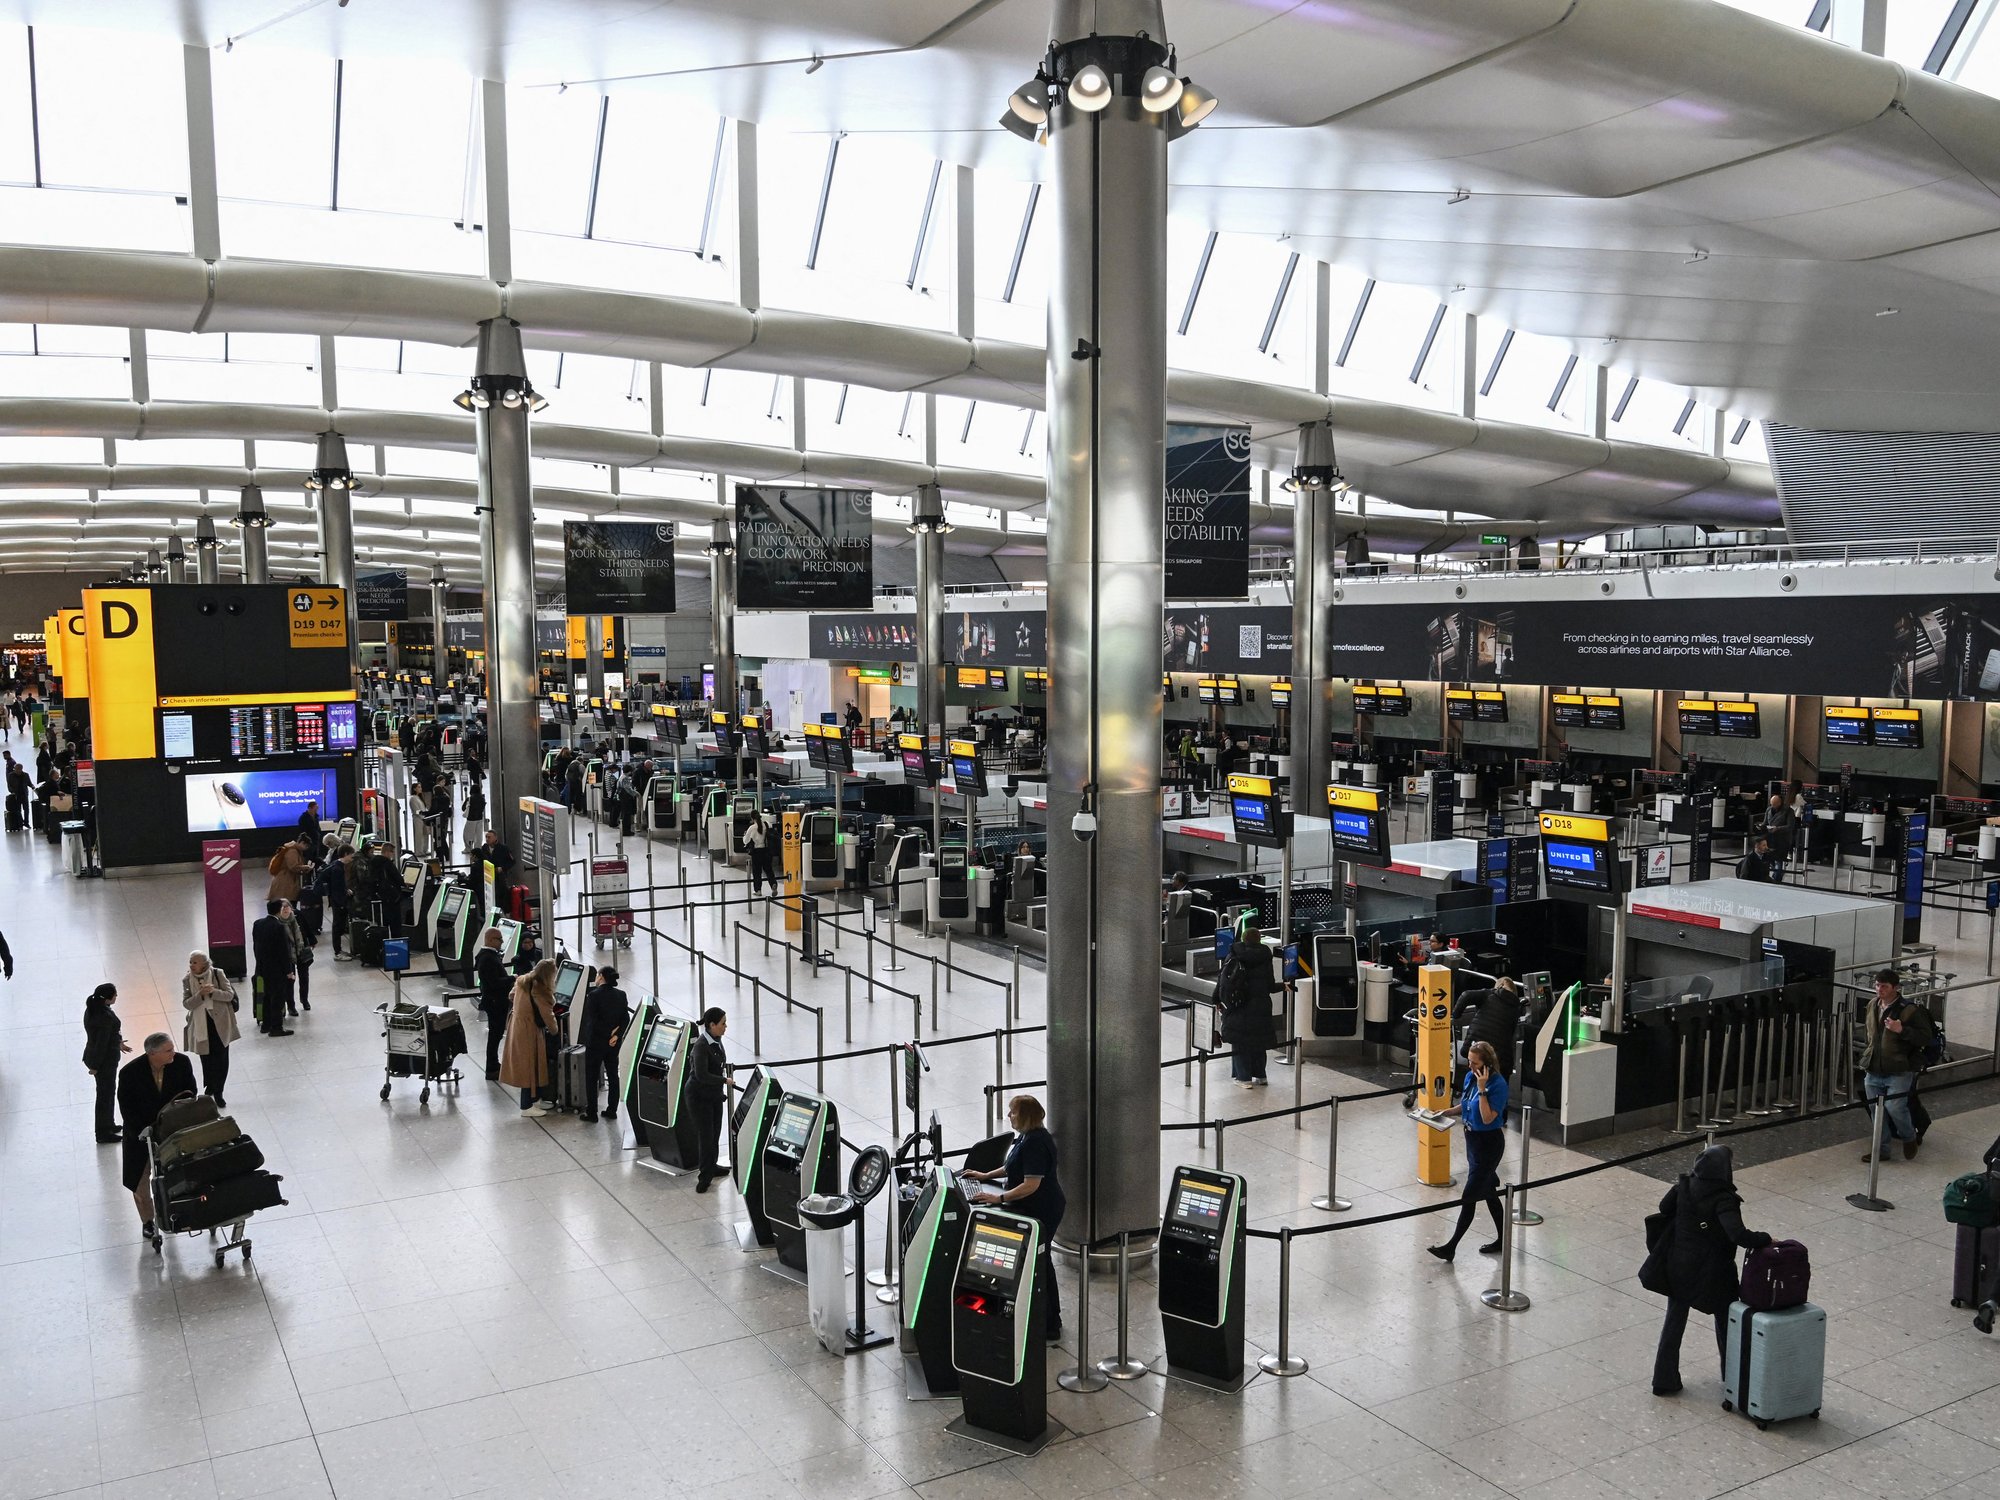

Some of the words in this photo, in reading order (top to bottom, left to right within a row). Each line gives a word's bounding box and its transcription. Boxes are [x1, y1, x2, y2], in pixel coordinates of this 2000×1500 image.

[1228, 432, 1250, 450] SG
[855, 494, 872, 506] SG
[1167, 506, 1204, 522] EEDS
[659, 527, 674, 536] SG
[738, 522, 792, 534] RADICAL
[1165, 525, 1244, 541] ICTABILITY.
[758, 535, 829, 547] INNOVATION
[832, 537, 870, 548] NEEDS
[570, 549, 596, 558] YOUR
[598, 549, 621, 558] NEXT
[624, 549, 640, 558] BIG
[748, 548, 828, 560] CLOCKWORK
[607, 559, 637, 568] THING
[639, 559, 669, 568] NEEDS
[802, 561, 866, 573] PRECISION.
[600, 568, 646, 577] STABILITY.
[69, 615, 84, 635] C
[101, 600, 138, 638] D
[294, 620, 315, 628] D19
[320, 620, 341, 628] D47
[1563, 633, 1586, 642] From
[1588, 634, 1629, 644] checking
[1631, 634, 1638, 642] in
[1641, 634, 1650, 643] to
[1653, 634, 1688, 645] earning
[1691, 634, 1720, 644] miles,
[1722, 634, 1751, 643] travel
[1753, 635, 1814, 646] seamlessly
[1610, 645, 1640, 654] airlines
[1643, 645, 1661, 654] and
[1663, 646, 1700, 656] airports
[1702, 646, 1723, 655] with
[1725, 646, 1746, 656] Star
[1749, 646, 1793, 656] Alliance.
[1339, 792, 1351, 800] D17
[1555, 819, 1572, 829] D18
[1551, 852, 1580, 860] UNITED
